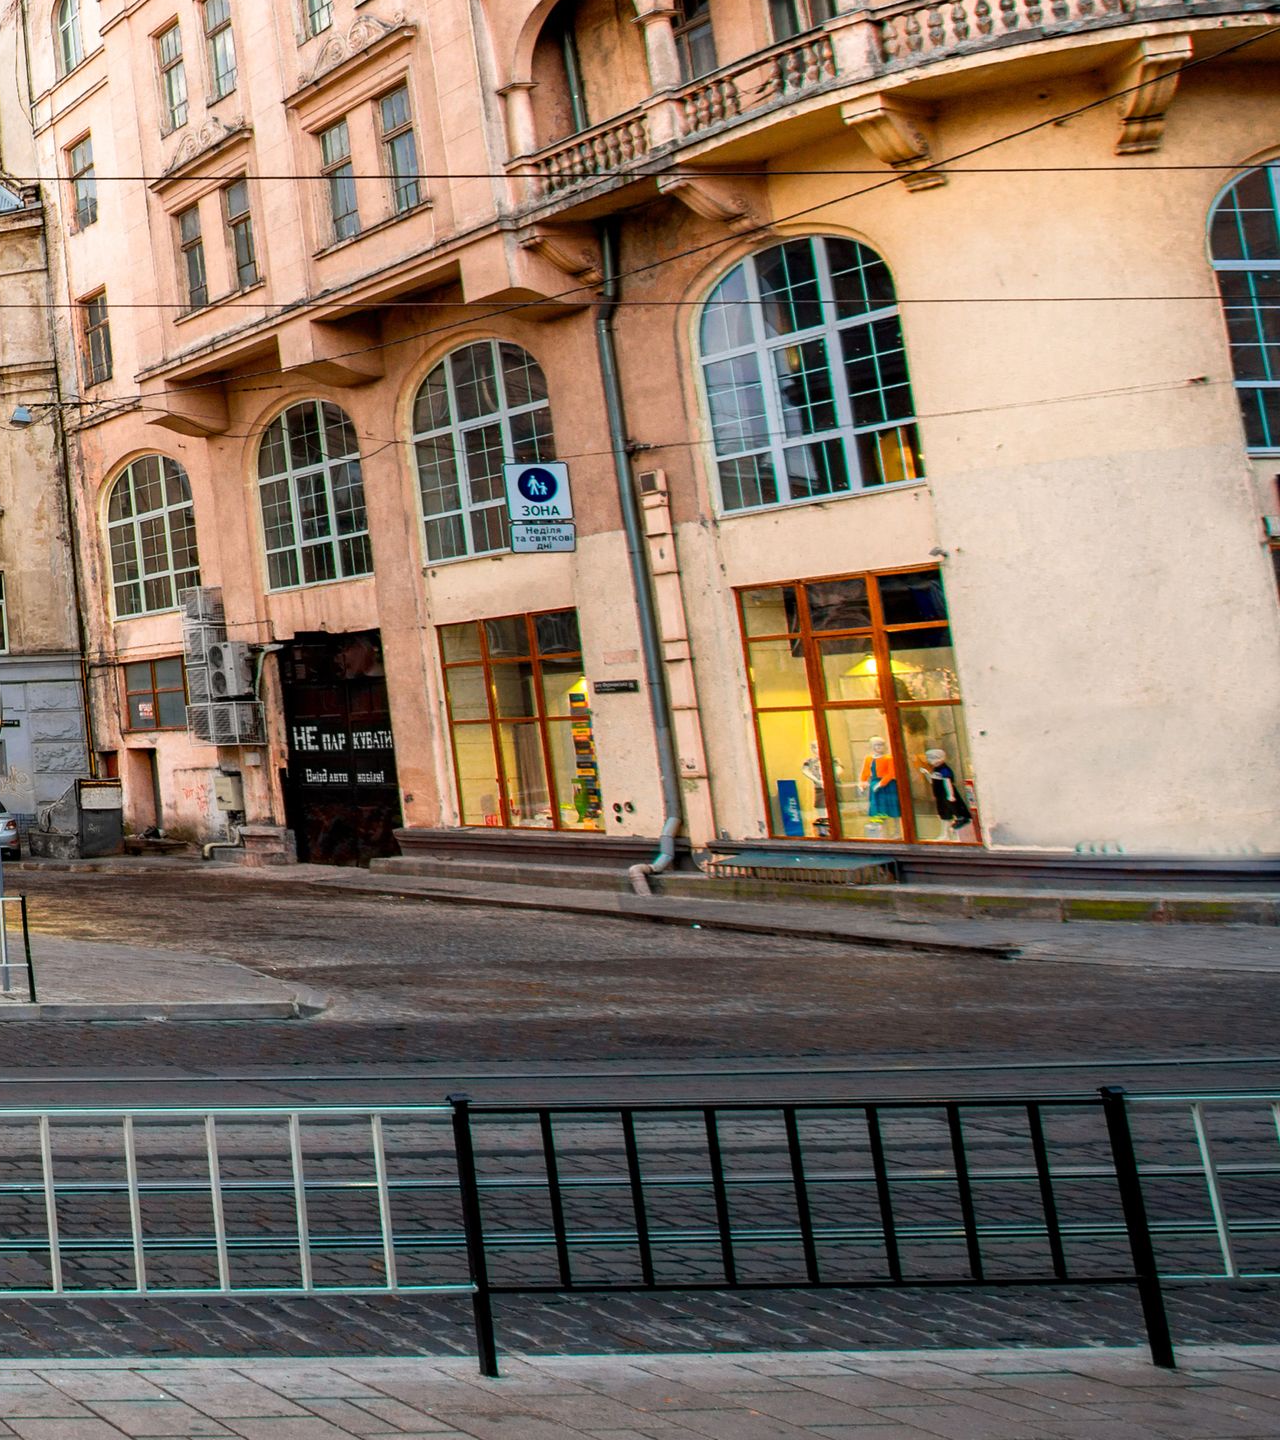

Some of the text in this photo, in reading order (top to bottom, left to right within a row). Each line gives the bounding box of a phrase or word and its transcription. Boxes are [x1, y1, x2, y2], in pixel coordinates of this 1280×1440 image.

[521, 505, 560, 516] ЗОНА
[525, 526, 562, 535] Неділя
[529, 534, 573, 543] святкові
[292, 726, 320, 751] НЕ
